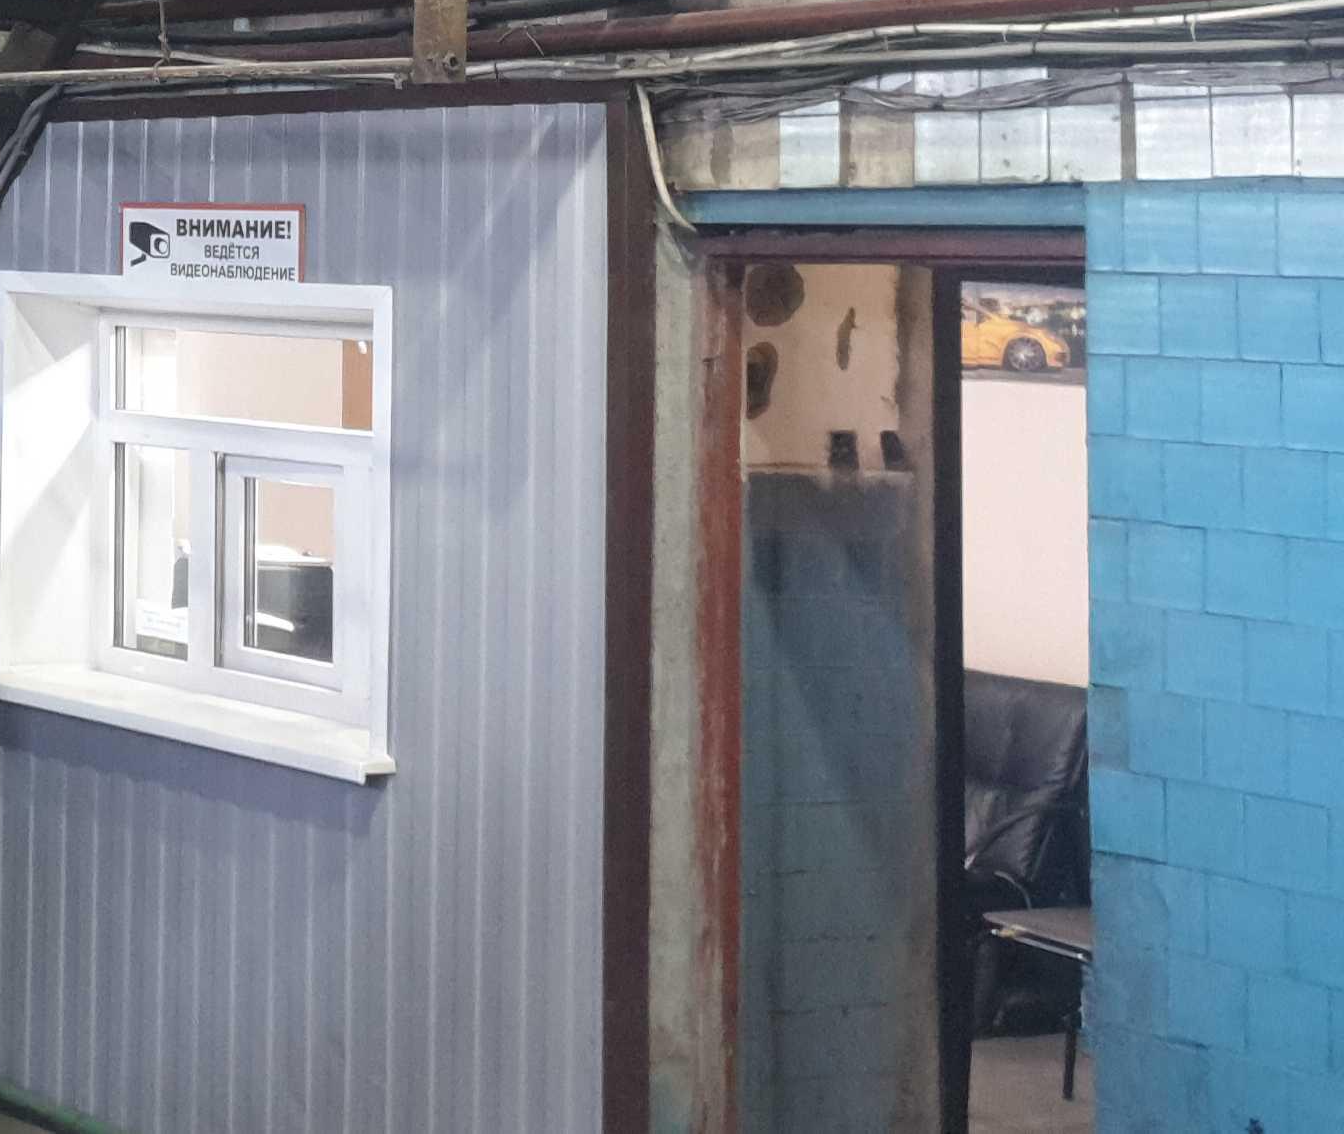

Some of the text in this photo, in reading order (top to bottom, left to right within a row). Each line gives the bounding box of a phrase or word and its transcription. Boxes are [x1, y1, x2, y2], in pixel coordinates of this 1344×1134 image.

[176, 218, 292, 239] ВНИМАНИЕ!
[204, 243, 259, 260] ВЕДЁТСЯ
[170, 262, 296, 282] ВИДЕОНАБЛЮДЕНИЕ
